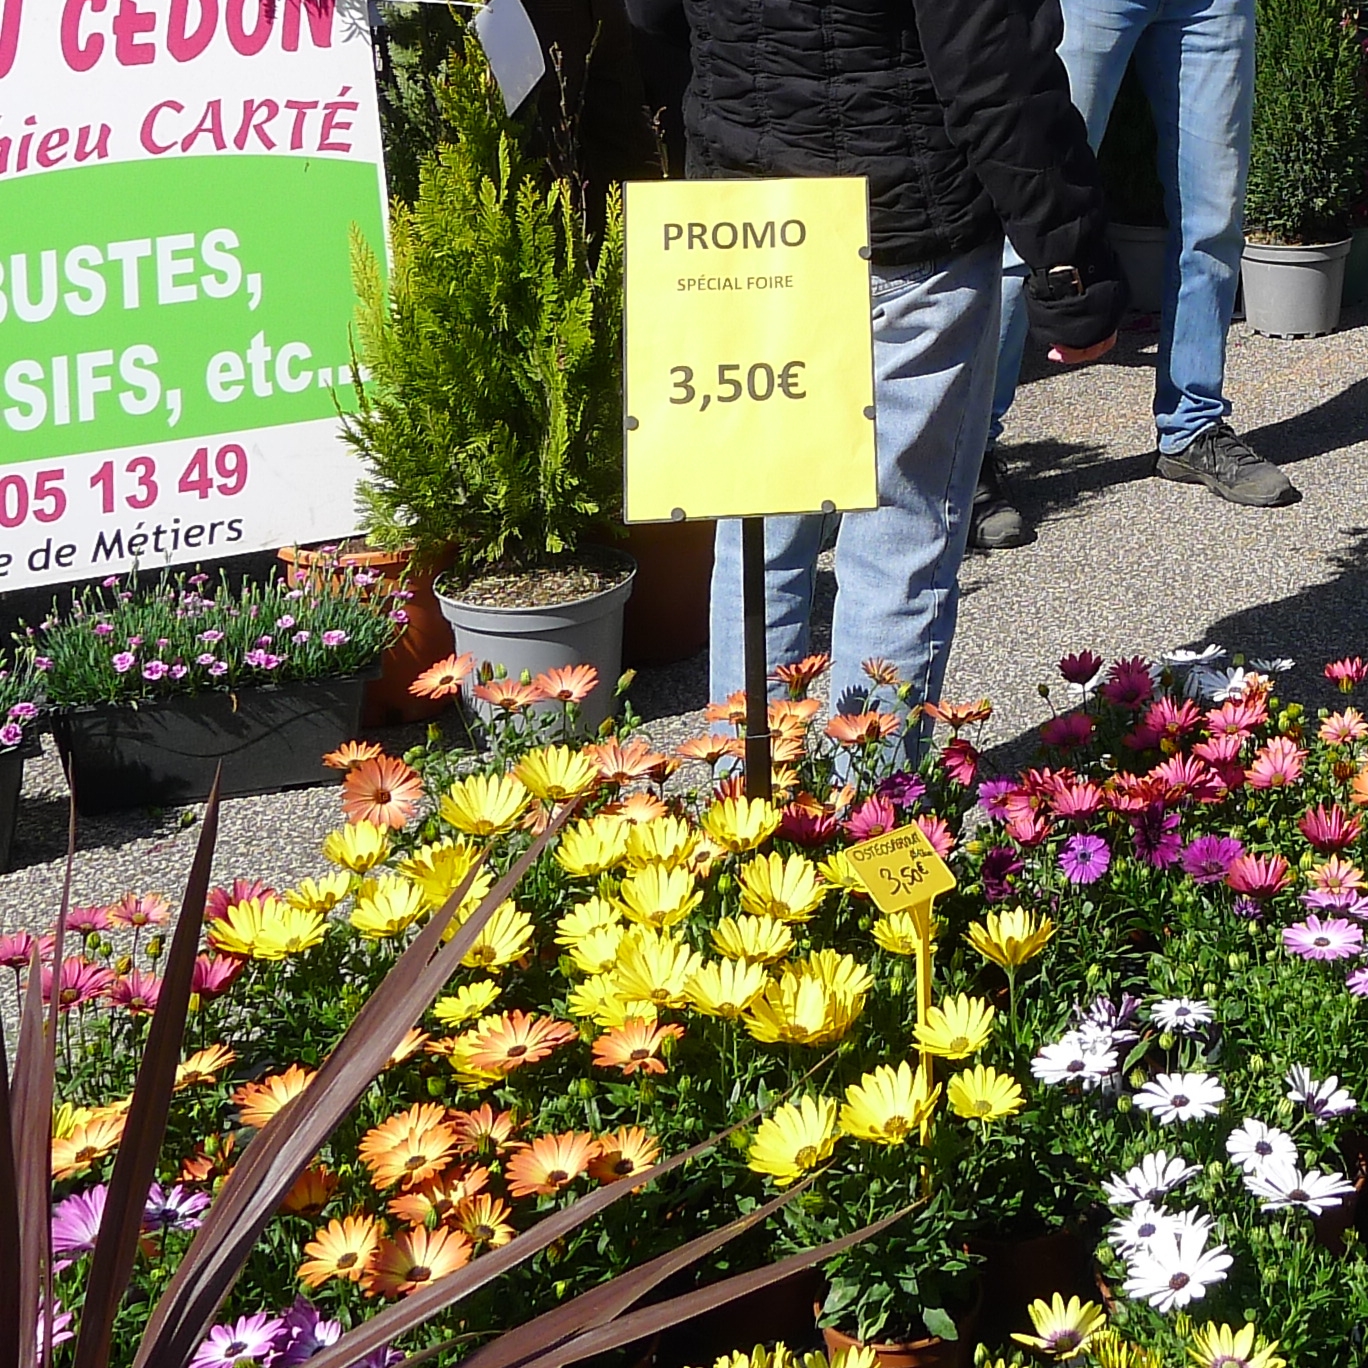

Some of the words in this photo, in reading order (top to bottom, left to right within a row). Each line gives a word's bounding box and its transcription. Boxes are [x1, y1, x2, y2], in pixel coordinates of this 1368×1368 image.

[140, 85, 359, 155] CARTÉ
[663, 219, 807, 251] PROMO
[0, 228, 263, 324] USTES,
[677, 274, 743, 292] SPÉCIAL
[747, 275, 794, 290] FOIRE
[669, 360, 807, 412] 3,50€
[0, 468, 67, 528] 05
[90, 460, 158, 513] 13
[179, 444, 248, 500] 49
[28, 537, 77, 572] de
[91, 518, 244, 563] Métiers
